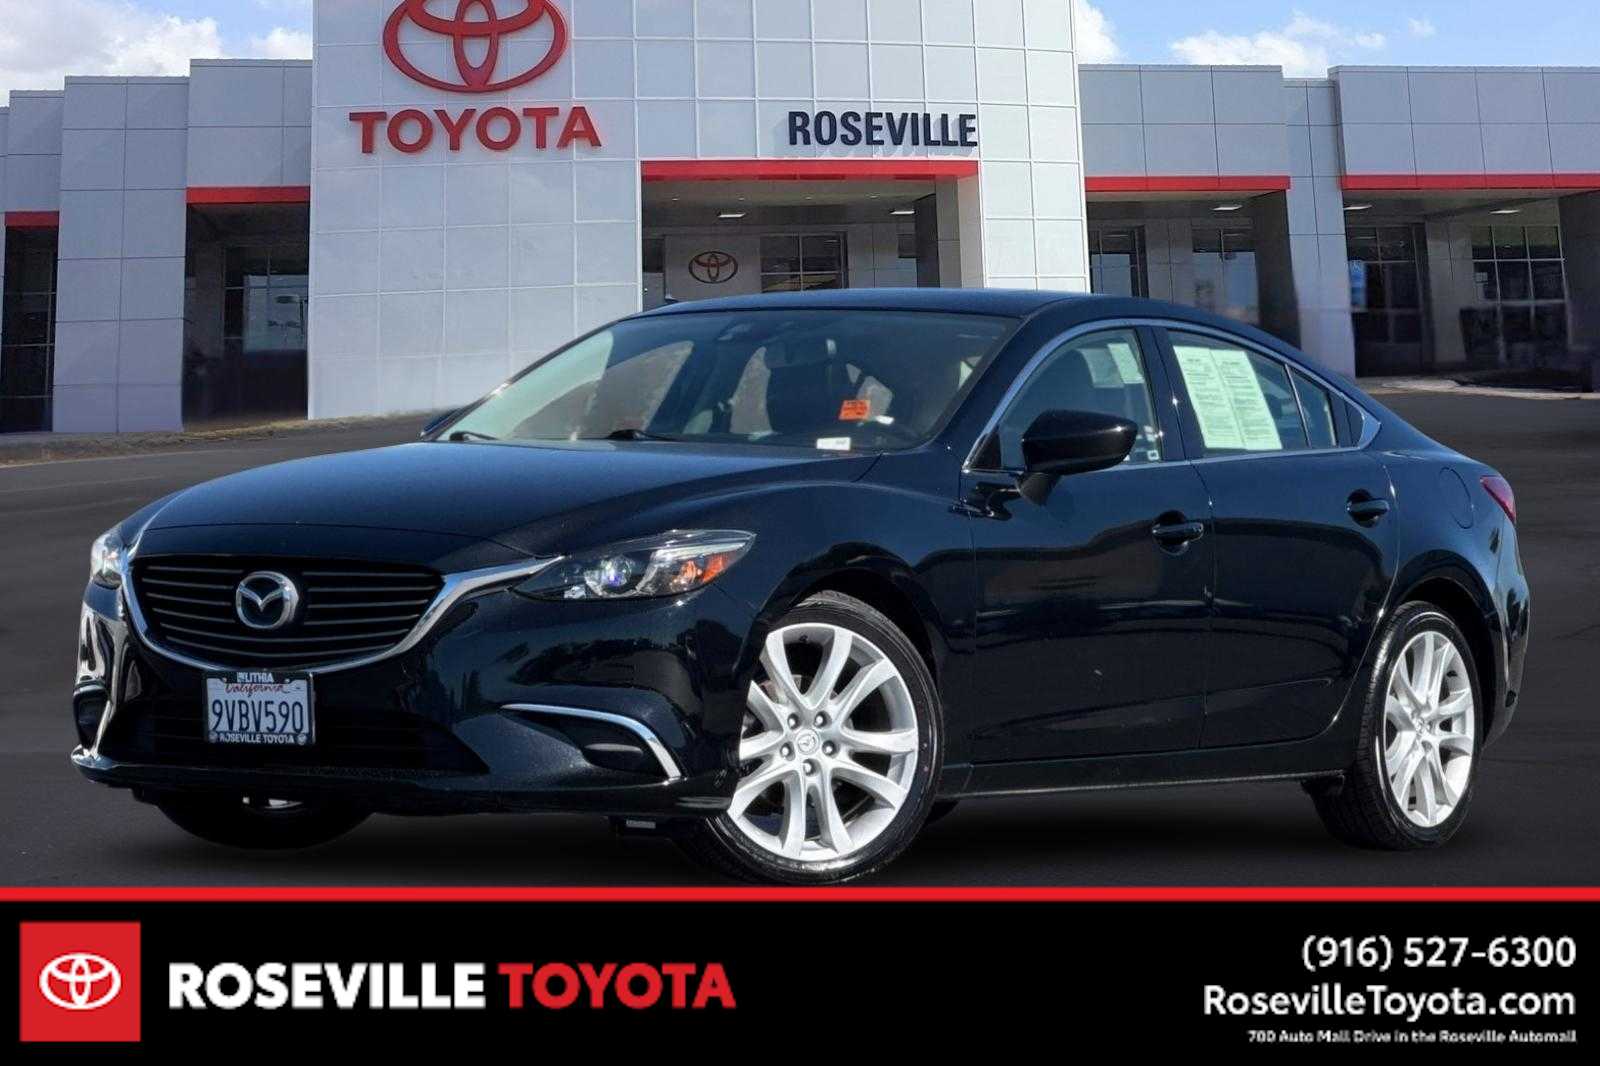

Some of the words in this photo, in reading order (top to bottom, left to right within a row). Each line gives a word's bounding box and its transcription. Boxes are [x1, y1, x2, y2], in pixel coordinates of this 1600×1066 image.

[349, 106, 602, 154] TOYOTA
[788, 111, 978, 147] ROSEVILLE
[212, 699, 303, 733] 9VBV590
[263, 734, 295, 743] TOYOTA
